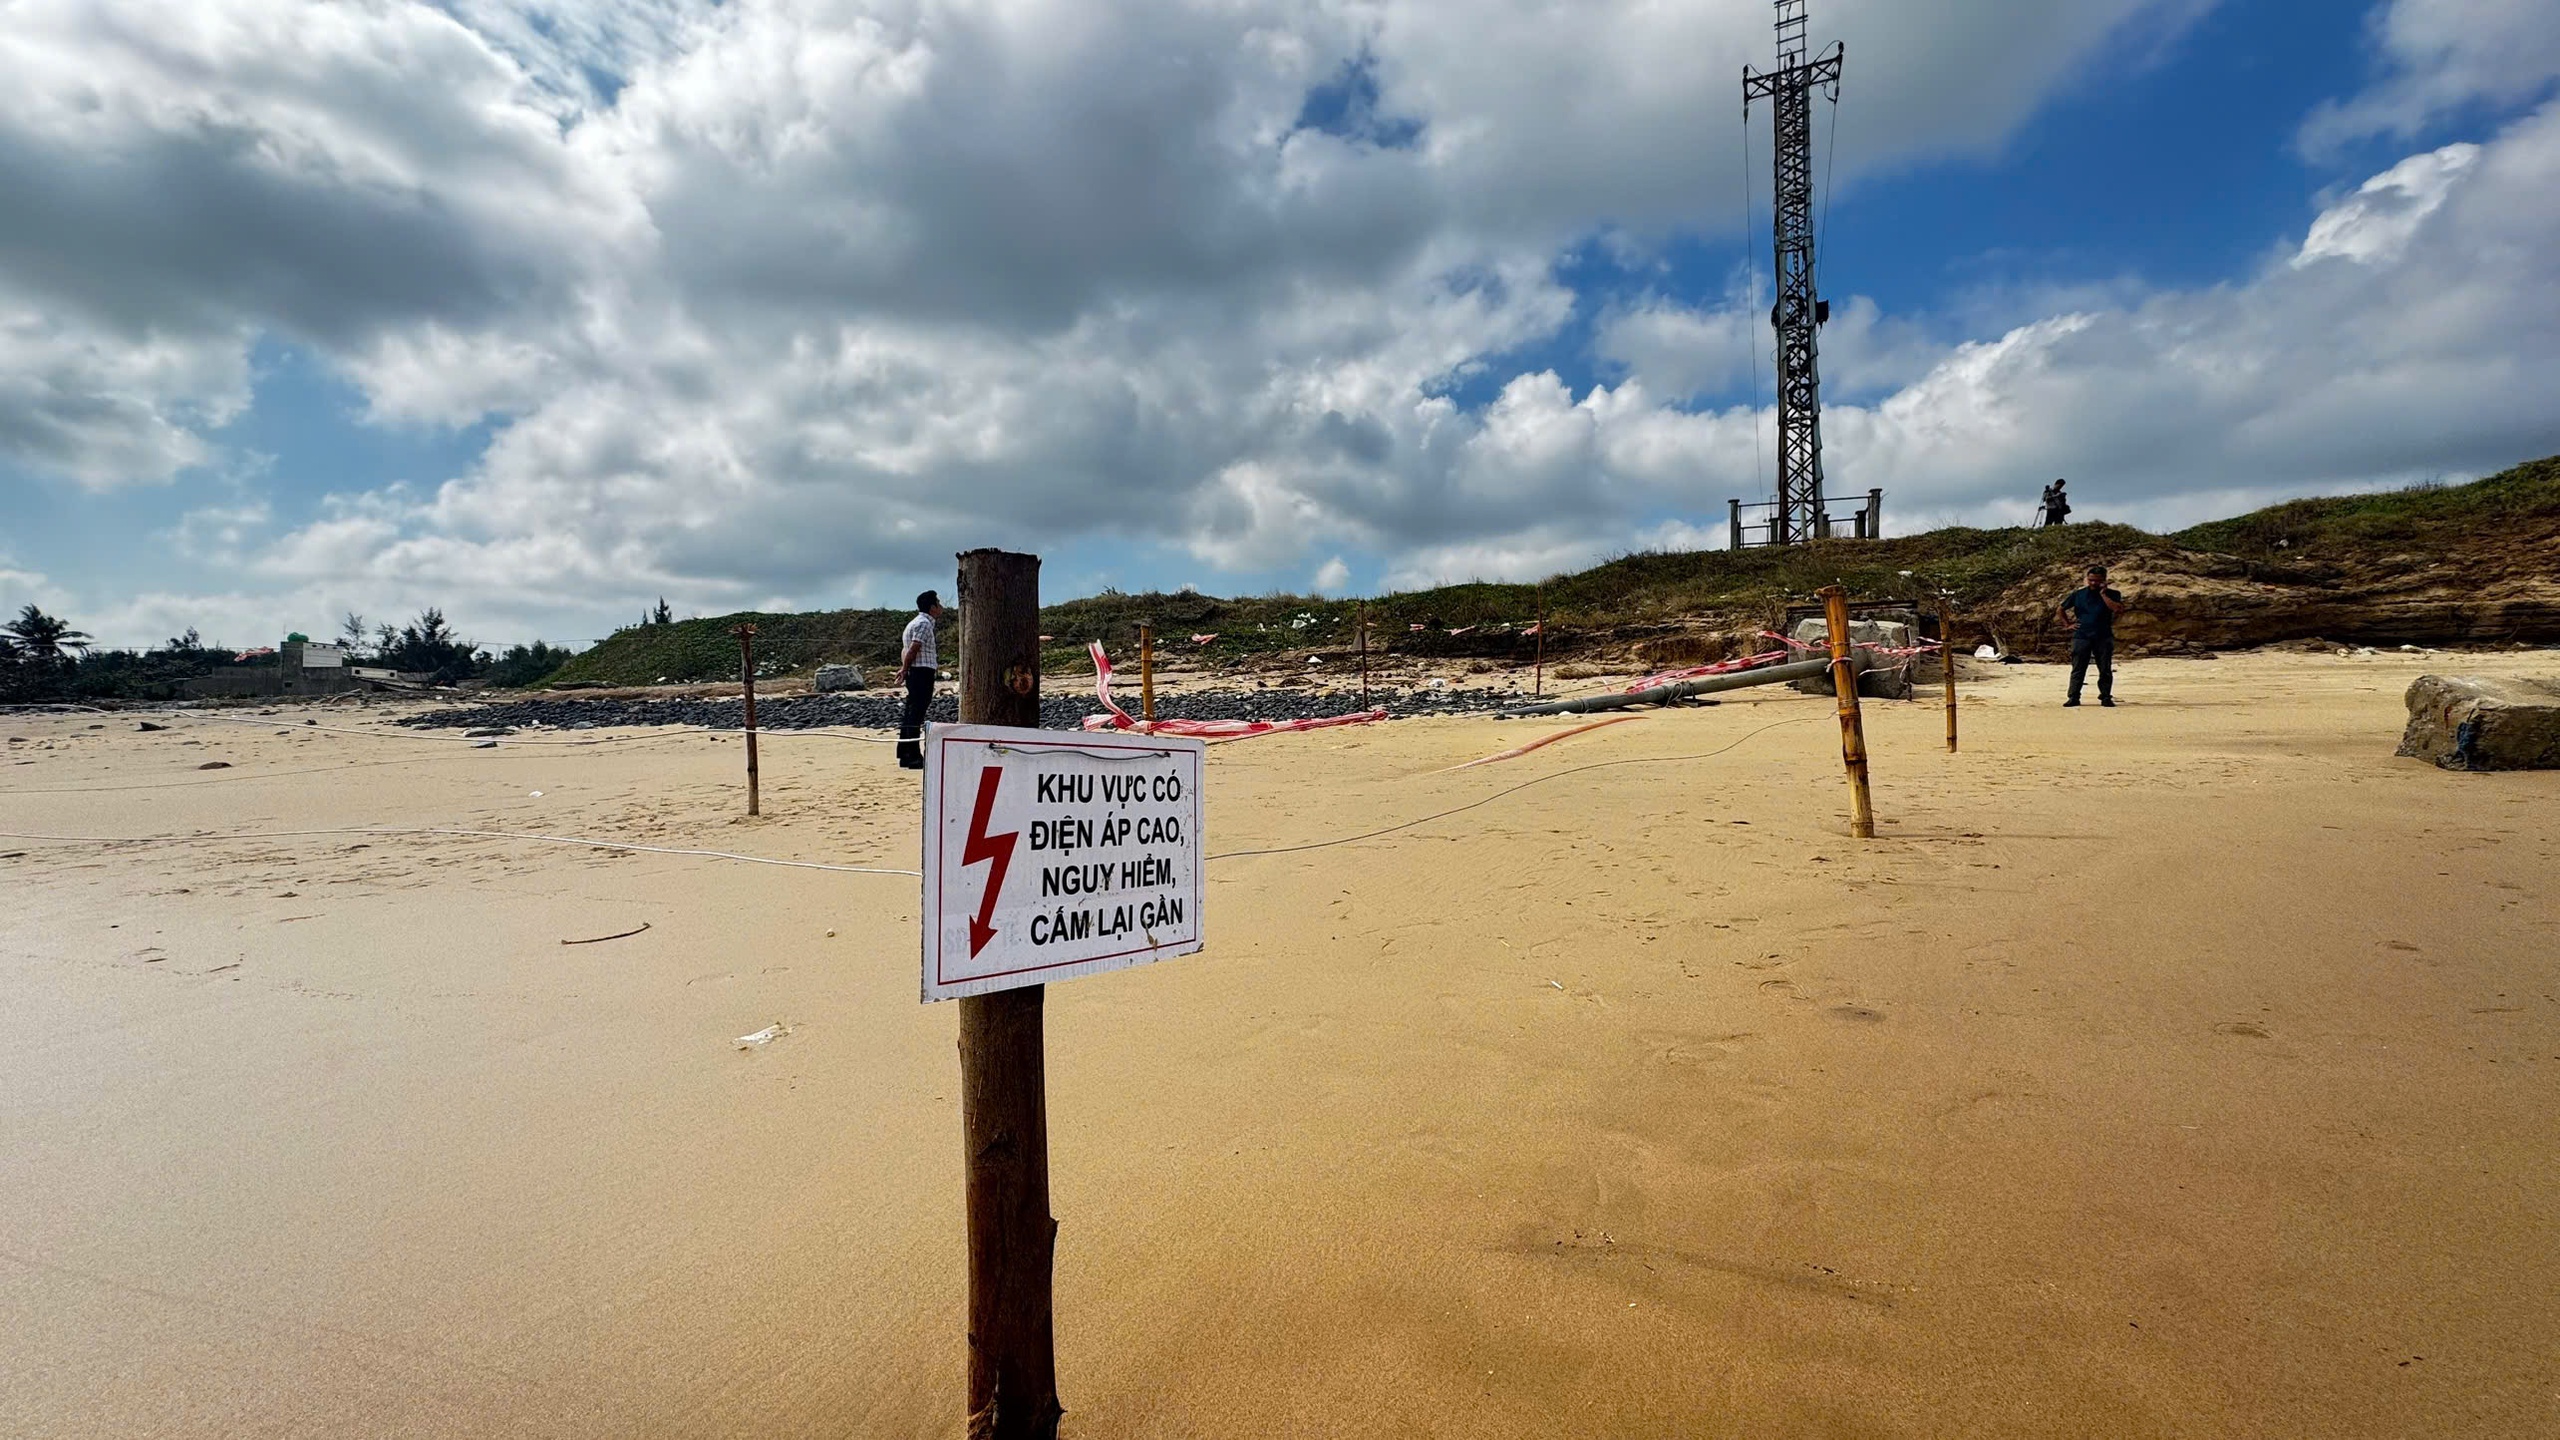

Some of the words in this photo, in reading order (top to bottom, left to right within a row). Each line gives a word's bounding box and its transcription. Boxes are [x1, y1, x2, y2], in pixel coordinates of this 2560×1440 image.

[1037, 773, 1094, 803] KHU
[1101, 774, 1147, 809] VỰC
[1153, 769, 1181, 802] CÓ
[1029, 815, 1093, 856] ĐIỆN
[1100, 811, 1131, 847] ÁP
[1137, 816, 1184, 847] CAO,
[1042, 862, 1115, 897] NGUY
[1121, 853, 1176, 889] HIỂM,
[1030, 906, 1090, 946] CẤM
[1098, 904, 1133, 941] LẠI
[1140, 894, 1183, 929] GẦN
